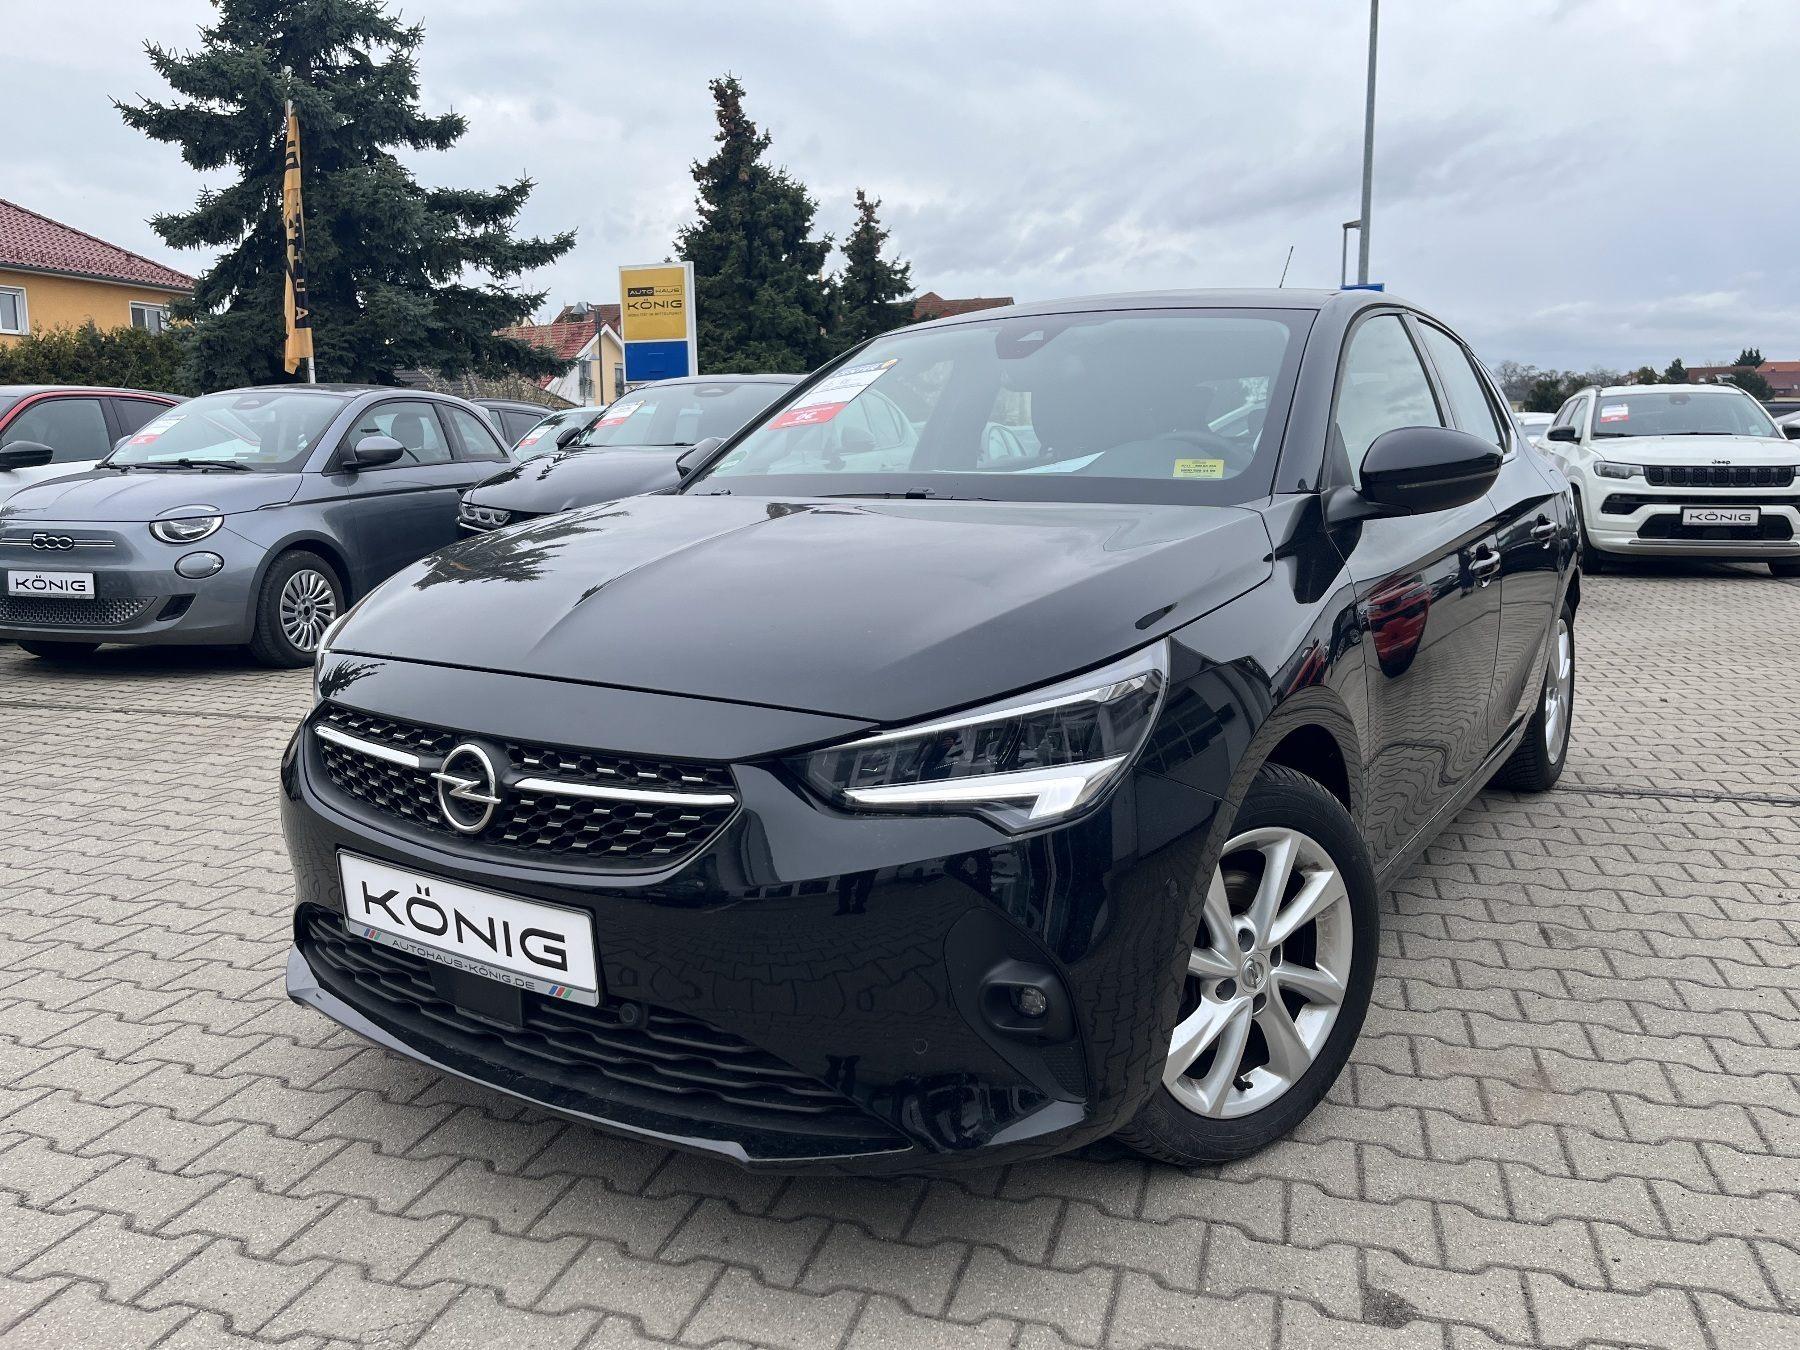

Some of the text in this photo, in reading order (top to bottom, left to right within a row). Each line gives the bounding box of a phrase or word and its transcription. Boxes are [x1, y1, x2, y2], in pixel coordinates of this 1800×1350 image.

[627, 298, 682, 311] KÖNIG
[1711, 458, 1731, 466] Jeep
[1689, 511, 1752, 522] KÖNIG
[32, 533, 74, 550] 500
[15, 574, 86, 592] KÖNIG
[361, 880, 568, 972] KÖNIG
